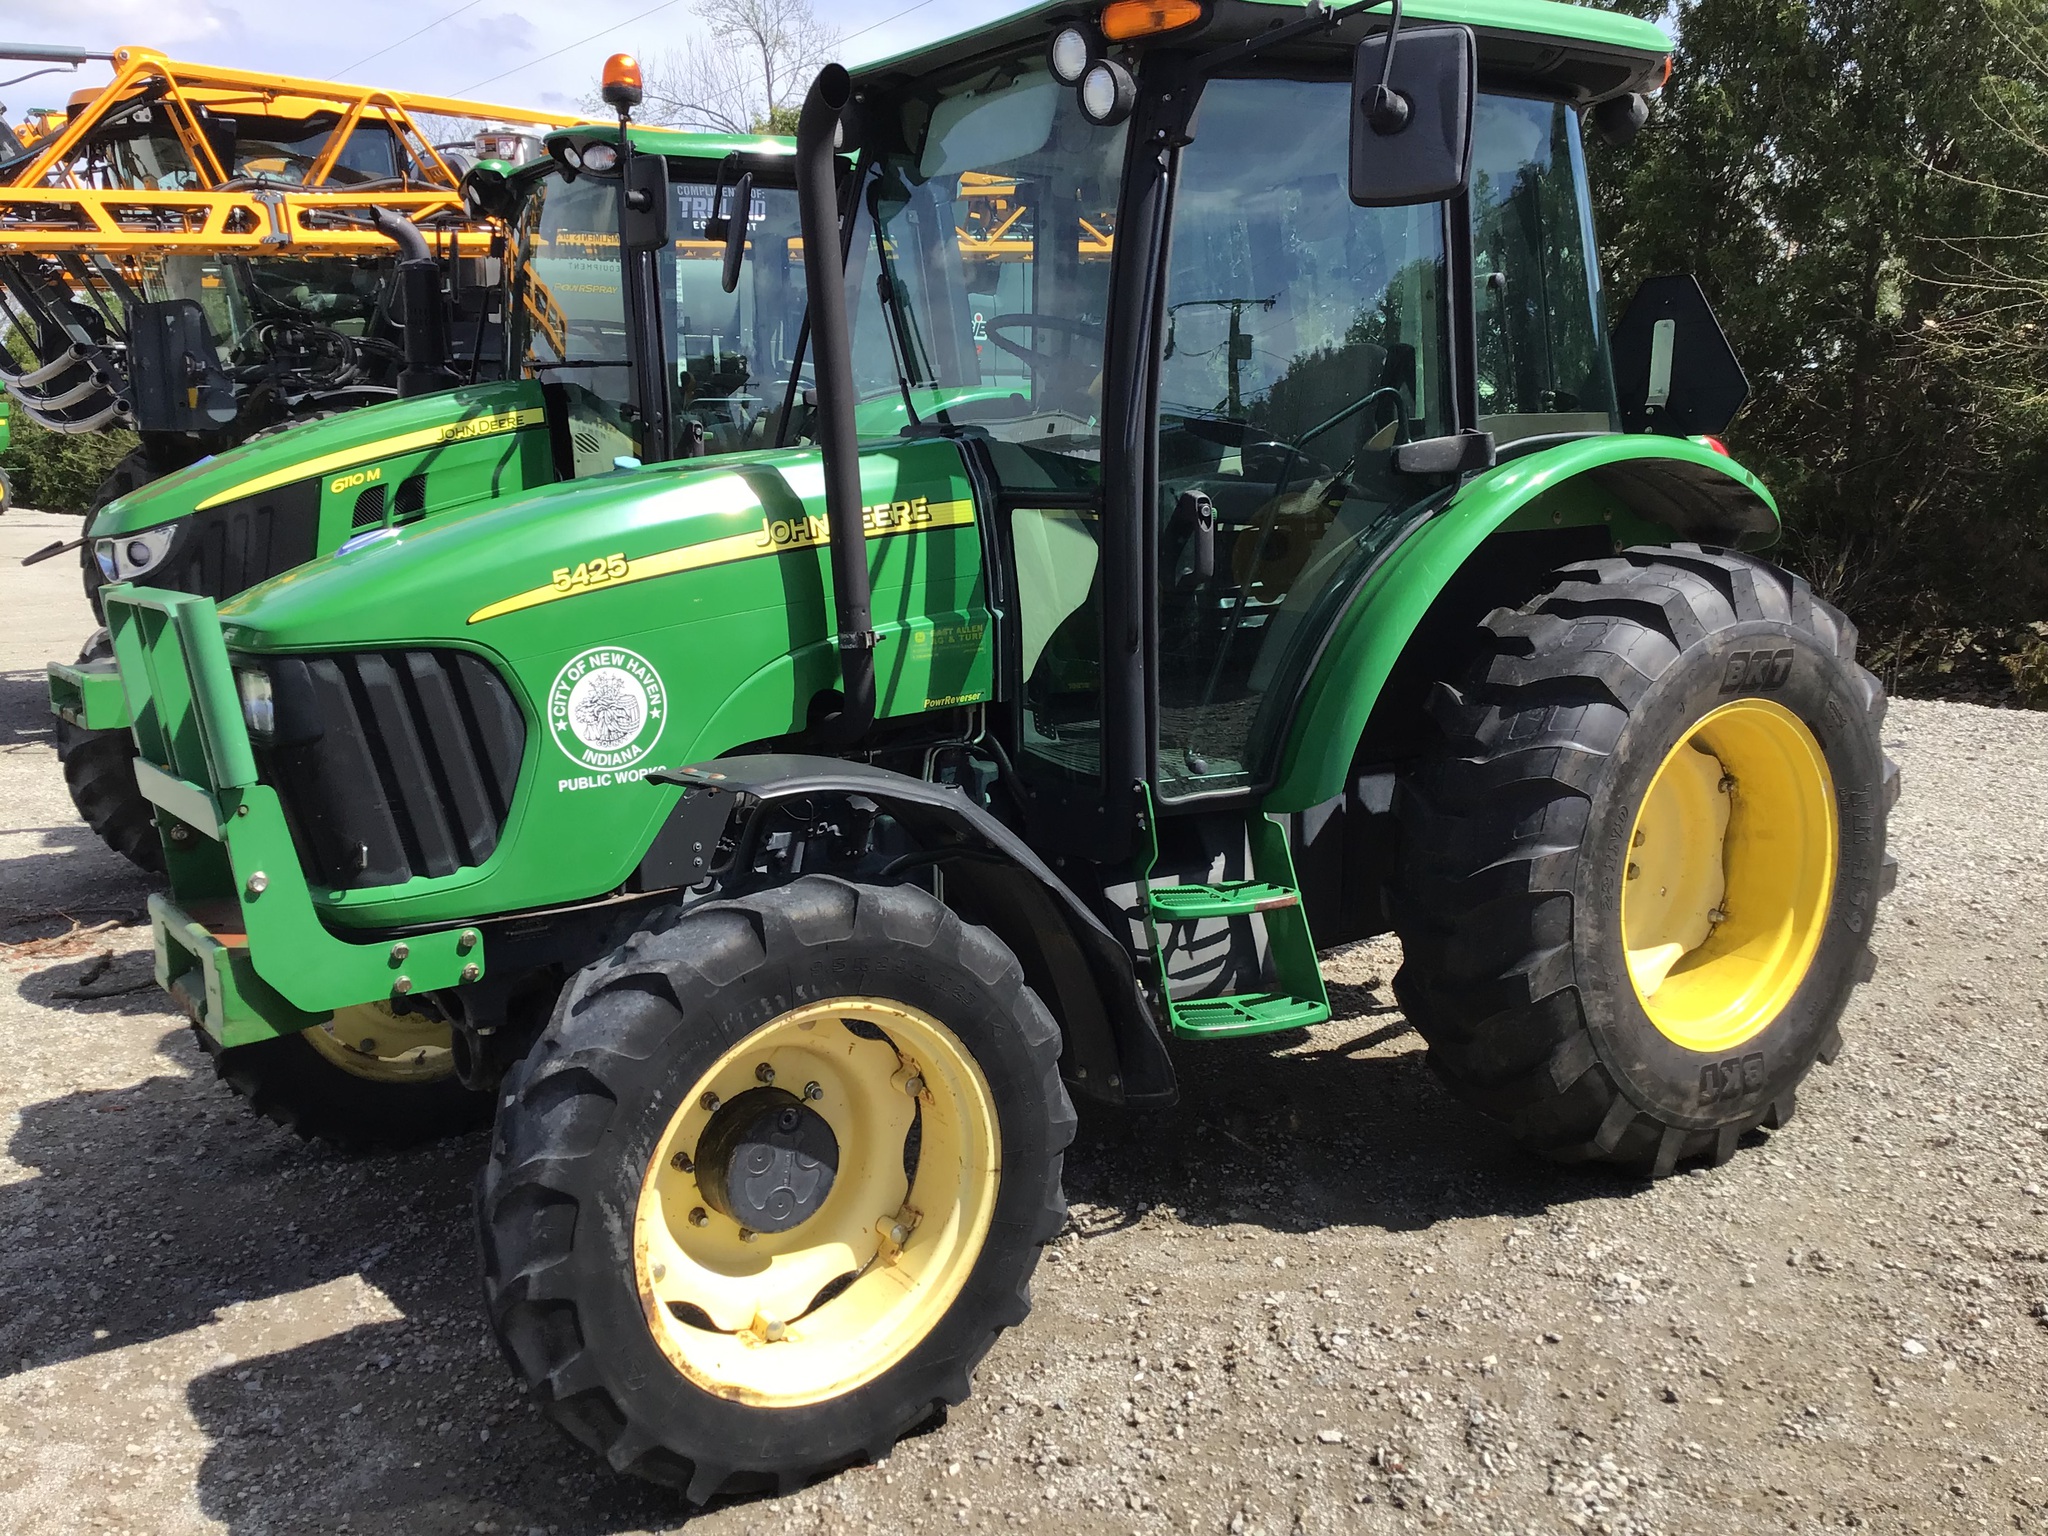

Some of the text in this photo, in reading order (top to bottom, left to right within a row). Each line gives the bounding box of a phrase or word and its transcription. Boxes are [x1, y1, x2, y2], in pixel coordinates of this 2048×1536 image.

[436, 415, 525, 442] JOHN DEERE
[756, 496, 932, 547] JOHN EERE
[552, 552, 630, 592] 5425
[553, 653, 662, 717] CITY OF NEW HAVEN
[1720, 650, 1795, 693] BKT
[923, 692, 981, 709] PowrReverser
[581, 744, 643, 766] INDIANA
[558, 773, 611, 792] PUBLIC
